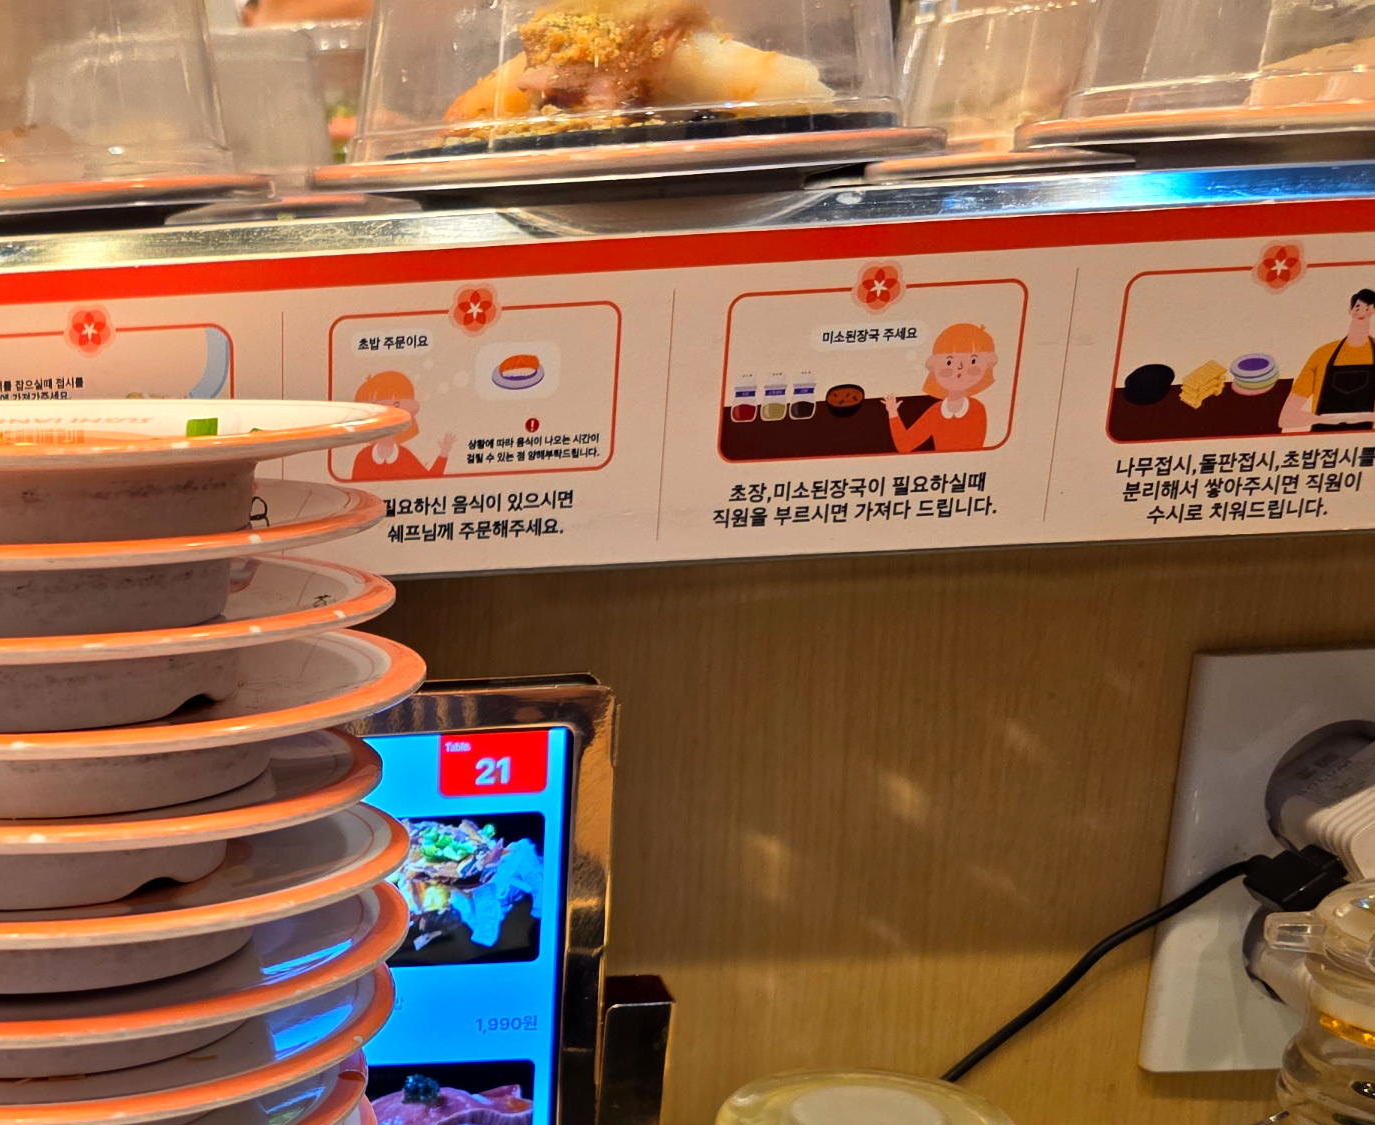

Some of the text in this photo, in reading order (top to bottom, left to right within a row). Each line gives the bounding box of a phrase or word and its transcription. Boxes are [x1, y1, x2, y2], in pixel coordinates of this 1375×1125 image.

[357, 335, 429, 351] 초밥 주문이요
[822, 326, 918, 345] 미소된장국 주세요
[15, 379, 53, 392] 잡으실때
[55, 376, 84, 390] 접시를
[468, 433, 600, 450] 상황에 따라 음식이 나오는 시간이
[485, 452, 495, 463] 수
[496, 451, 514, 463] 있는
[516, 450, 525, 461] 점
[727, 471, 987, 504] 초장,미소된장국이 필요하실때
[1122, 471, 1363, 502] 분리해서 쌓아주시면 직원이
[383, 489, 575, 518] 필요하신 음식이 있으시면
[712, 495, 997, 529] 직원을 부르시면 가져다 드립니다.
[1146, 497, 1328, 525] 수시로 치워드립니다.
[387, 516, 564, 544] 쉐프님께 주문해주세요.
[474, 756, 512, 786] 21
[474, 1014, 538, 1035] 1,990원
